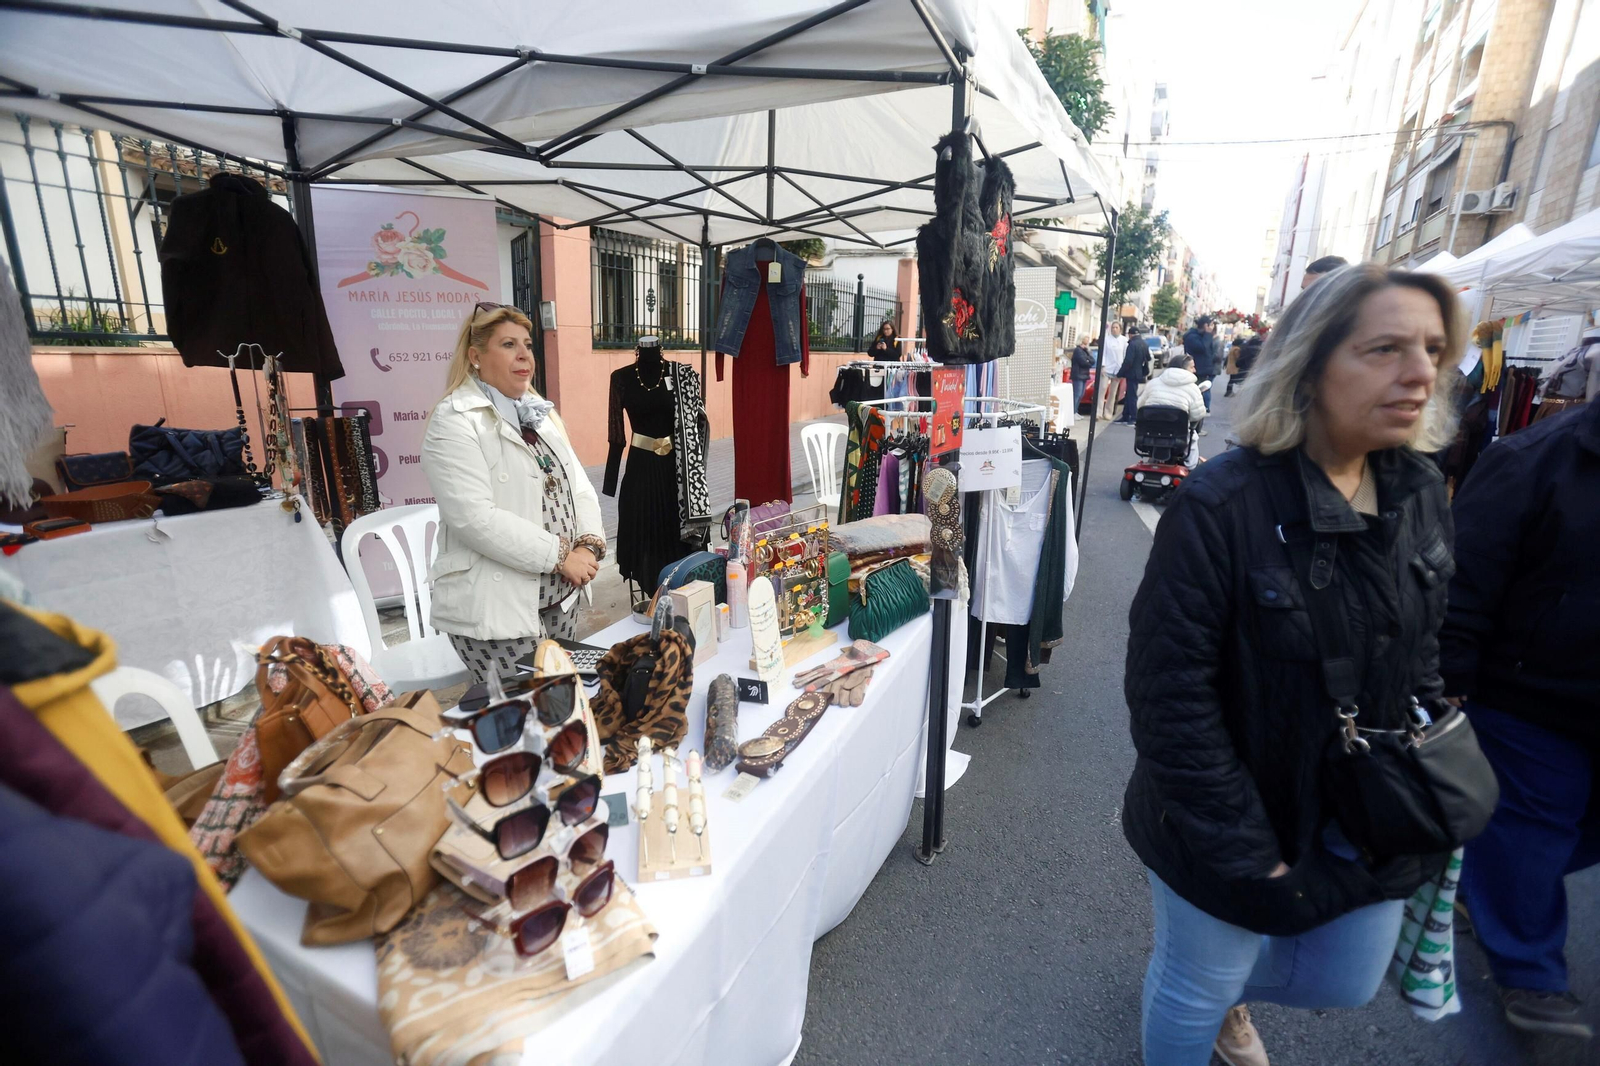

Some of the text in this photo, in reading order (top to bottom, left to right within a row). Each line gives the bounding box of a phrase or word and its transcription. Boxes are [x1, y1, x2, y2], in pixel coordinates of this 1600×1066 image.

[348, 288, 390, 302] MARÍA
[395, 288, 432, 303] JESÚS
[370, 308, 396, 319] CALLE
[431, 309, 456, 319] LOCAL
[457, 309, 463, 318] 1
[388, 352, 409, 362] 652
[412, 352, 431, 362] 921
[393, 410, 419, 422] María
